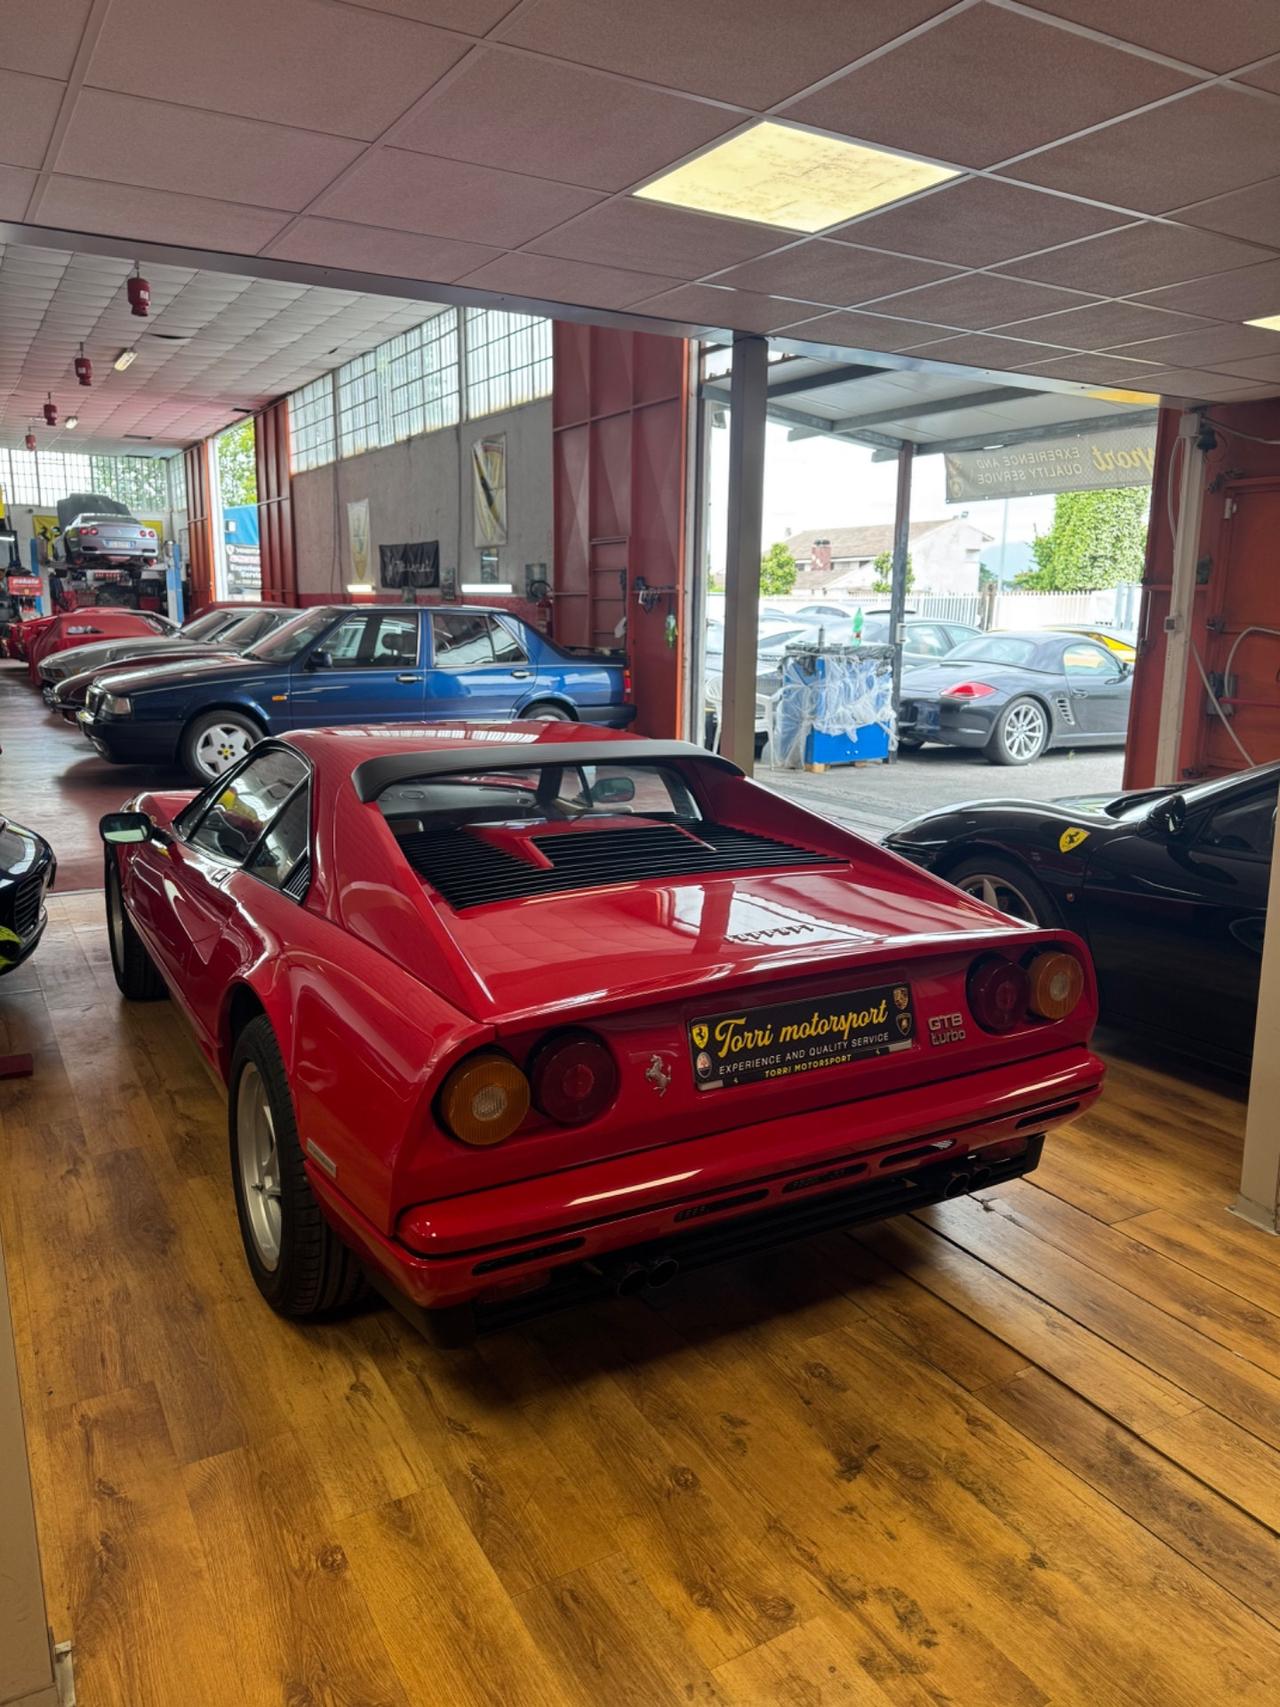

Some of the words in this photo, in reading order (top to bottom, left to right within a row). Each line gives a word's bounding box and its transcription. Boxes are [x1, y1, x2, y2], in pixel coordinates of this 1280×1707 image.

[714, 1016, 774, 1058] Torri
[779, 1000, 889, 1043] motorsport
[928, 1012, 964, 1031] GTB
[930, 1029, 967, 1046] turbo
[719, 1054, 782, 1075] EXPERIENCE
[785, 1048, 806, 1061] AND
[808, 1041, 848, 1056] QUALITY
[851, 1031, 889, 1048] SERVICE
[764, 1066, 792, 1078] TORRI
[794, 1054, 852, 1072] MOTORSPORT
